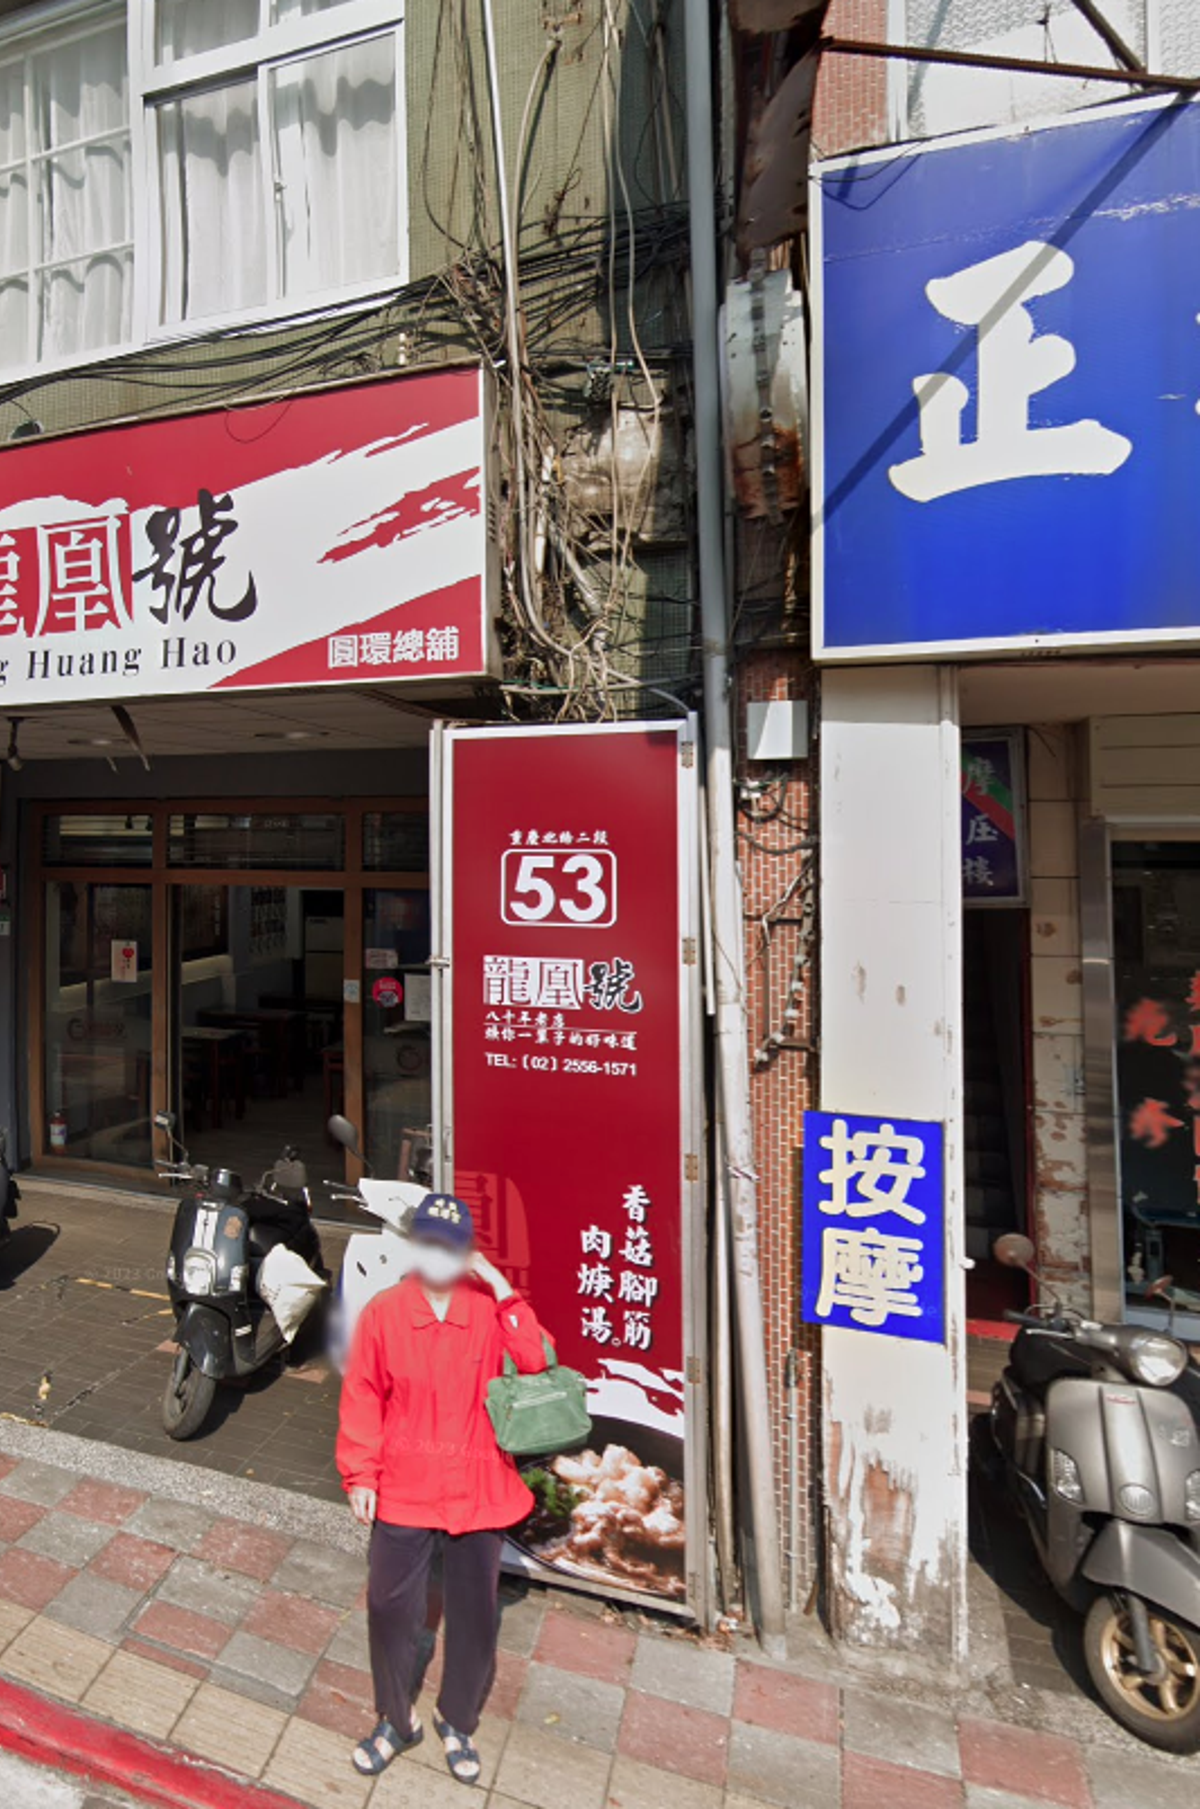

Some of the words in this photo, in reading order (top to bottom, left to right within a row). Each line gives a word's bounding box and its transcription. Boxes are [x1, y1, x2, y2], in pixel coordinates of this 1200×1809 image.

[888, 240, 1133, 503] 正
[26, 646, 142, 680] Huang
[160, 636, 238, 669] Hao
[508, 853, 607, 923] 53
[484, 1052, 517, 1069] TEL:
[617, 1184, 658, 1351] 香菇腳筋
[815, 1119, 927, 1328] 按摩
